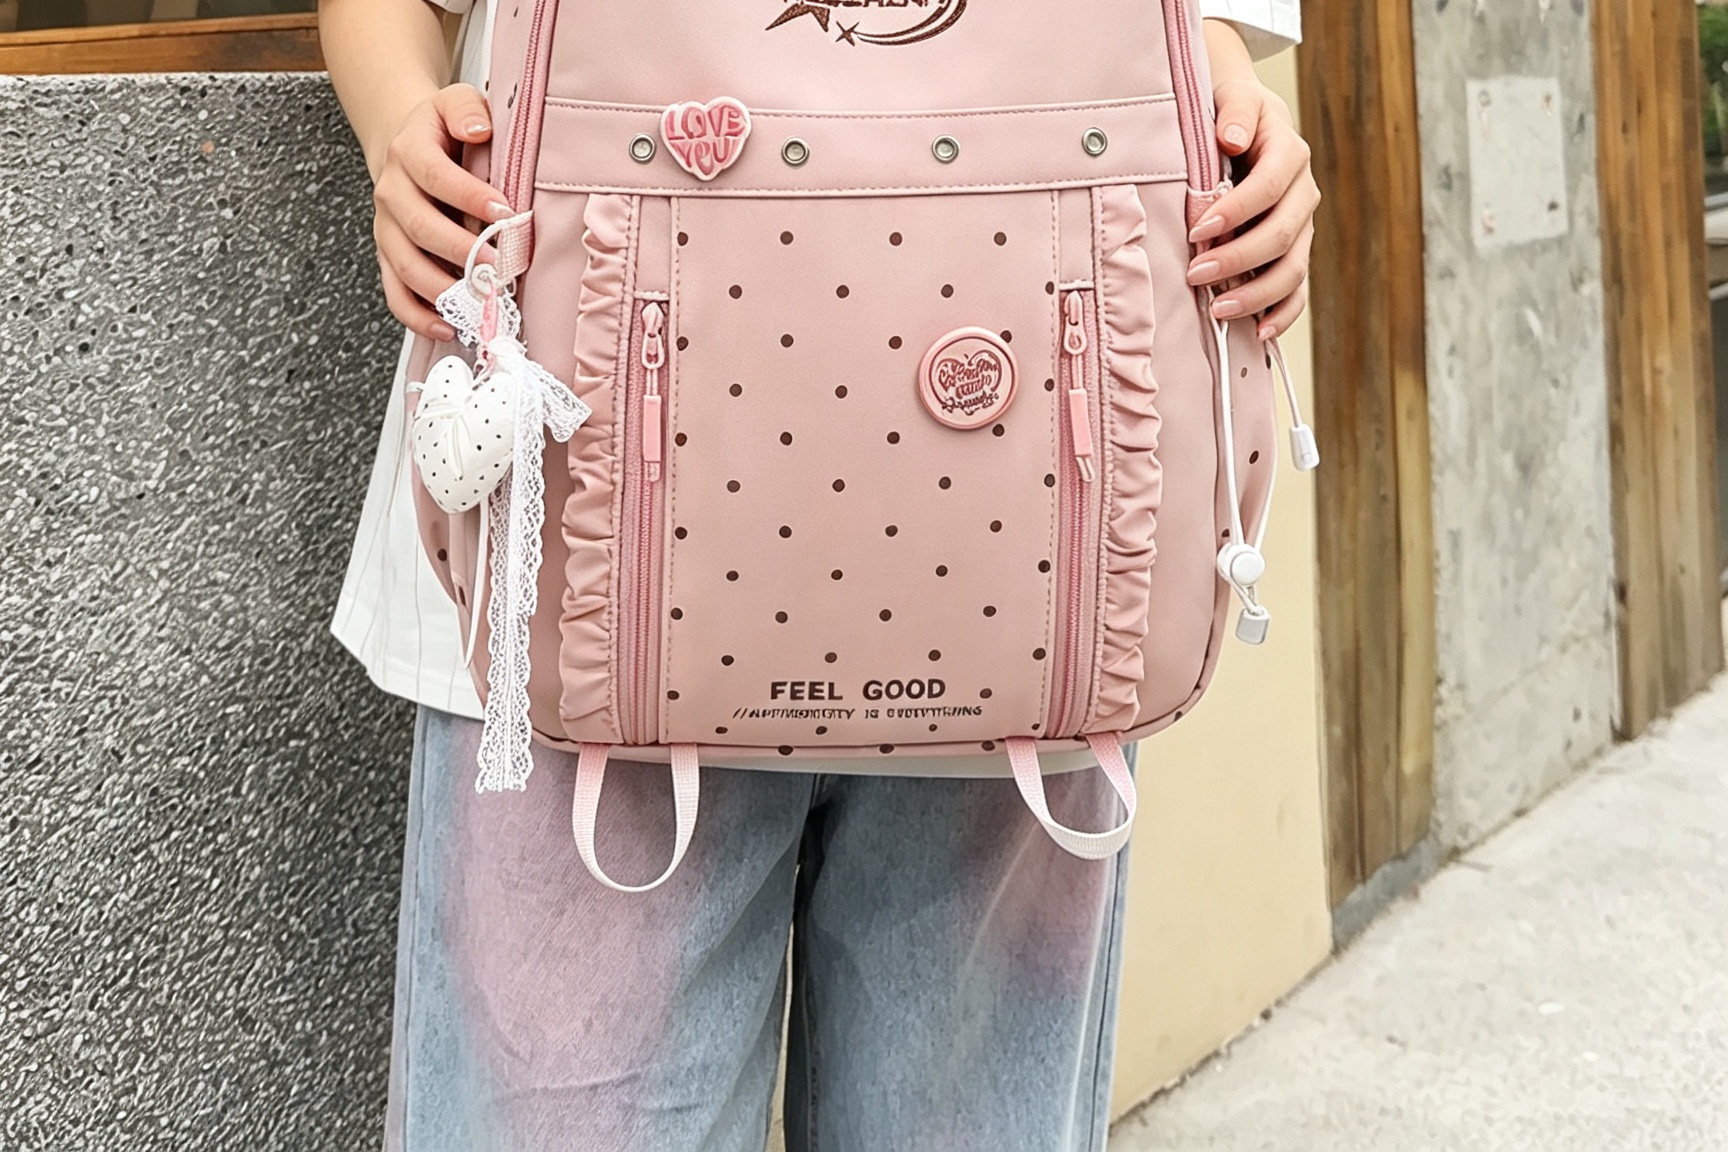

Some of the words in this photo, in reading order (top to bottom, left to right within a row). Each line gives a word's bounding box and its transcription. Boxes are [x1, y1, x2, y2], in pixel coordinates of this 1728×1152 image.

[665, 104, 745, 140] LOVE
[770, 681, 844, 701] FEEL
[862, 678, 946, 701] GOOD
